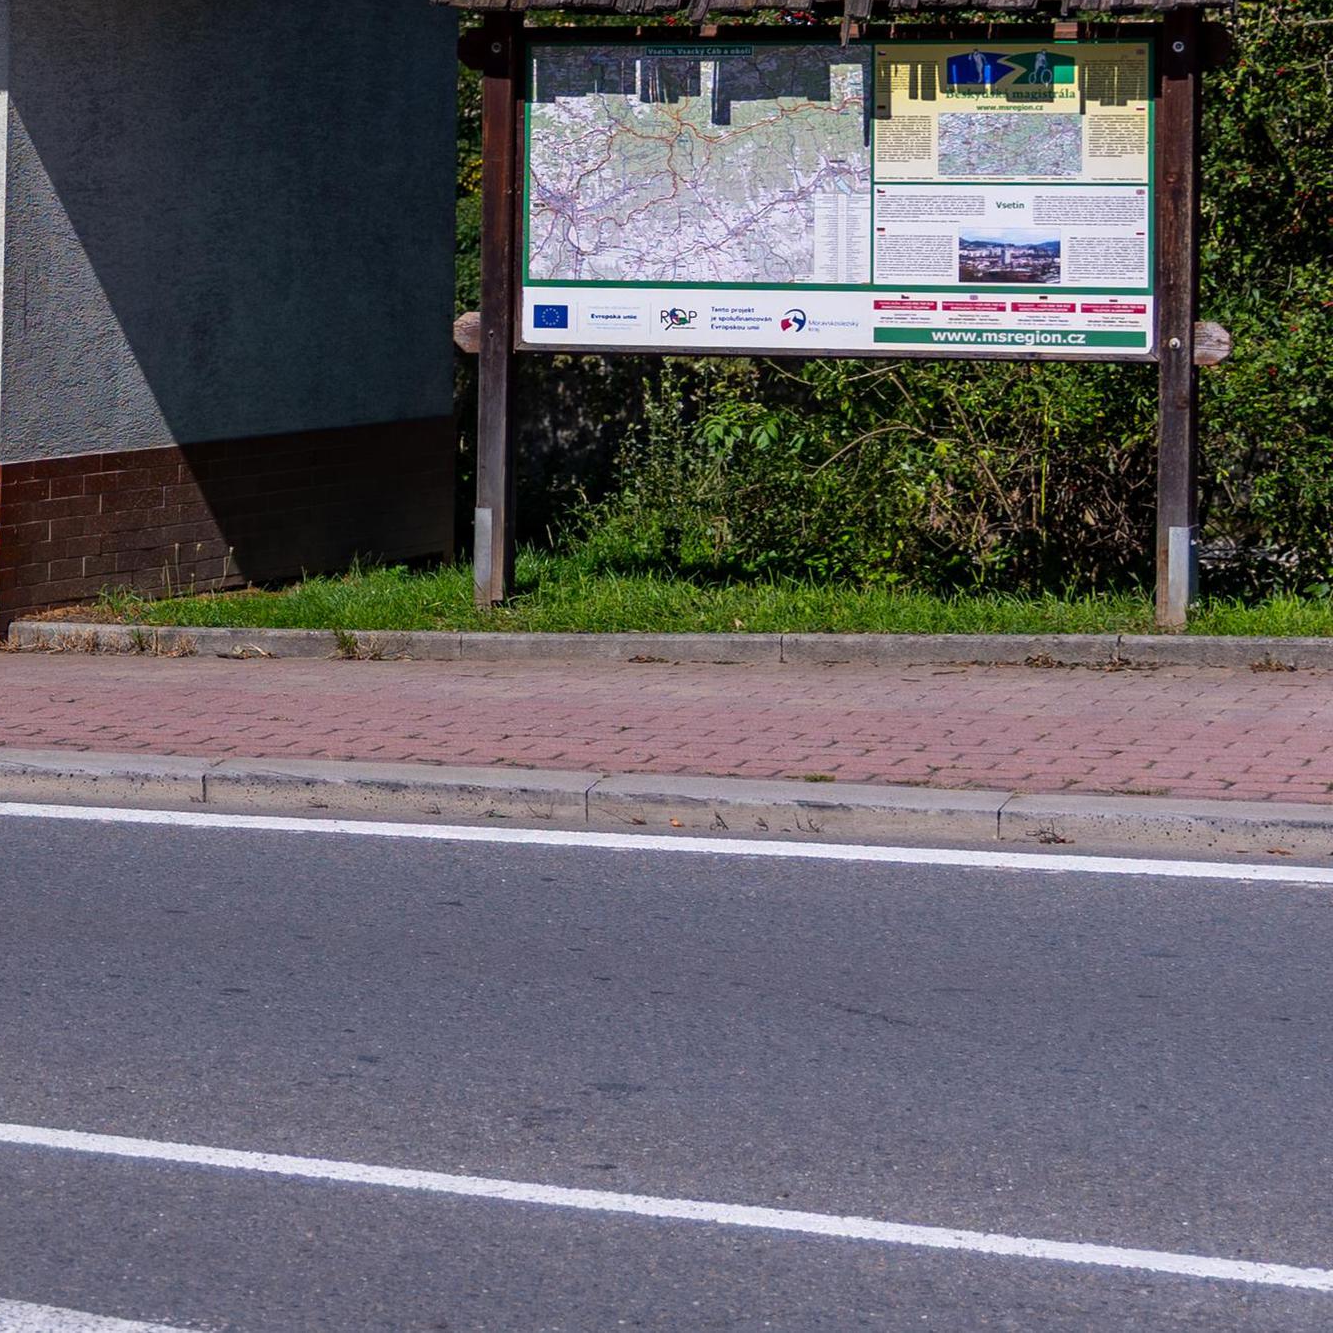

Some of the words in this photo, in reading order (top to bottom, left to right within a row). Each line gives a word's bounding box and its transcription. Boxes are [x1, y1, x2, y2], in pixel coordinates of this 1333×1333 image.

[1012, 88, 1075, 101] magistrála
[976, 104, 1044, 112] www.msregion.cz
[931, 331, 1086, 346] www.msregion.cz
